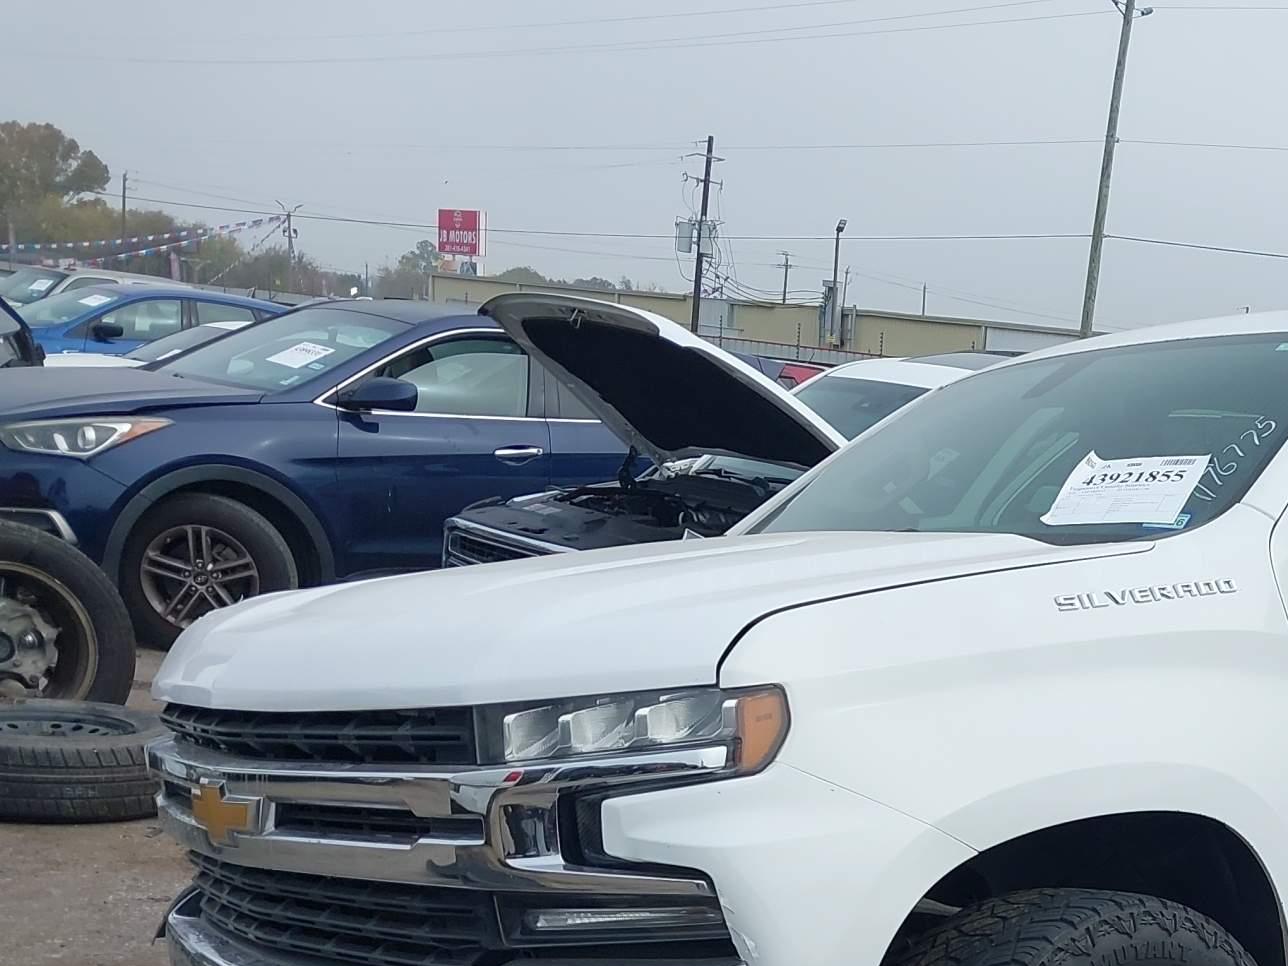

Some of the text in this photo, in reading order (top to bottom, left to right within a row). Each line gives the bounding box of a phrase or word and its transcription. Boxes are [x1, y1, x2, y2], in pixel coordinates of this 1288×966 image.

[448, 230, 476, 244] MOTORS
[1082, 469, 1187, 487] 43921855
[1054, 577, 1237, 612] SILVERADO
